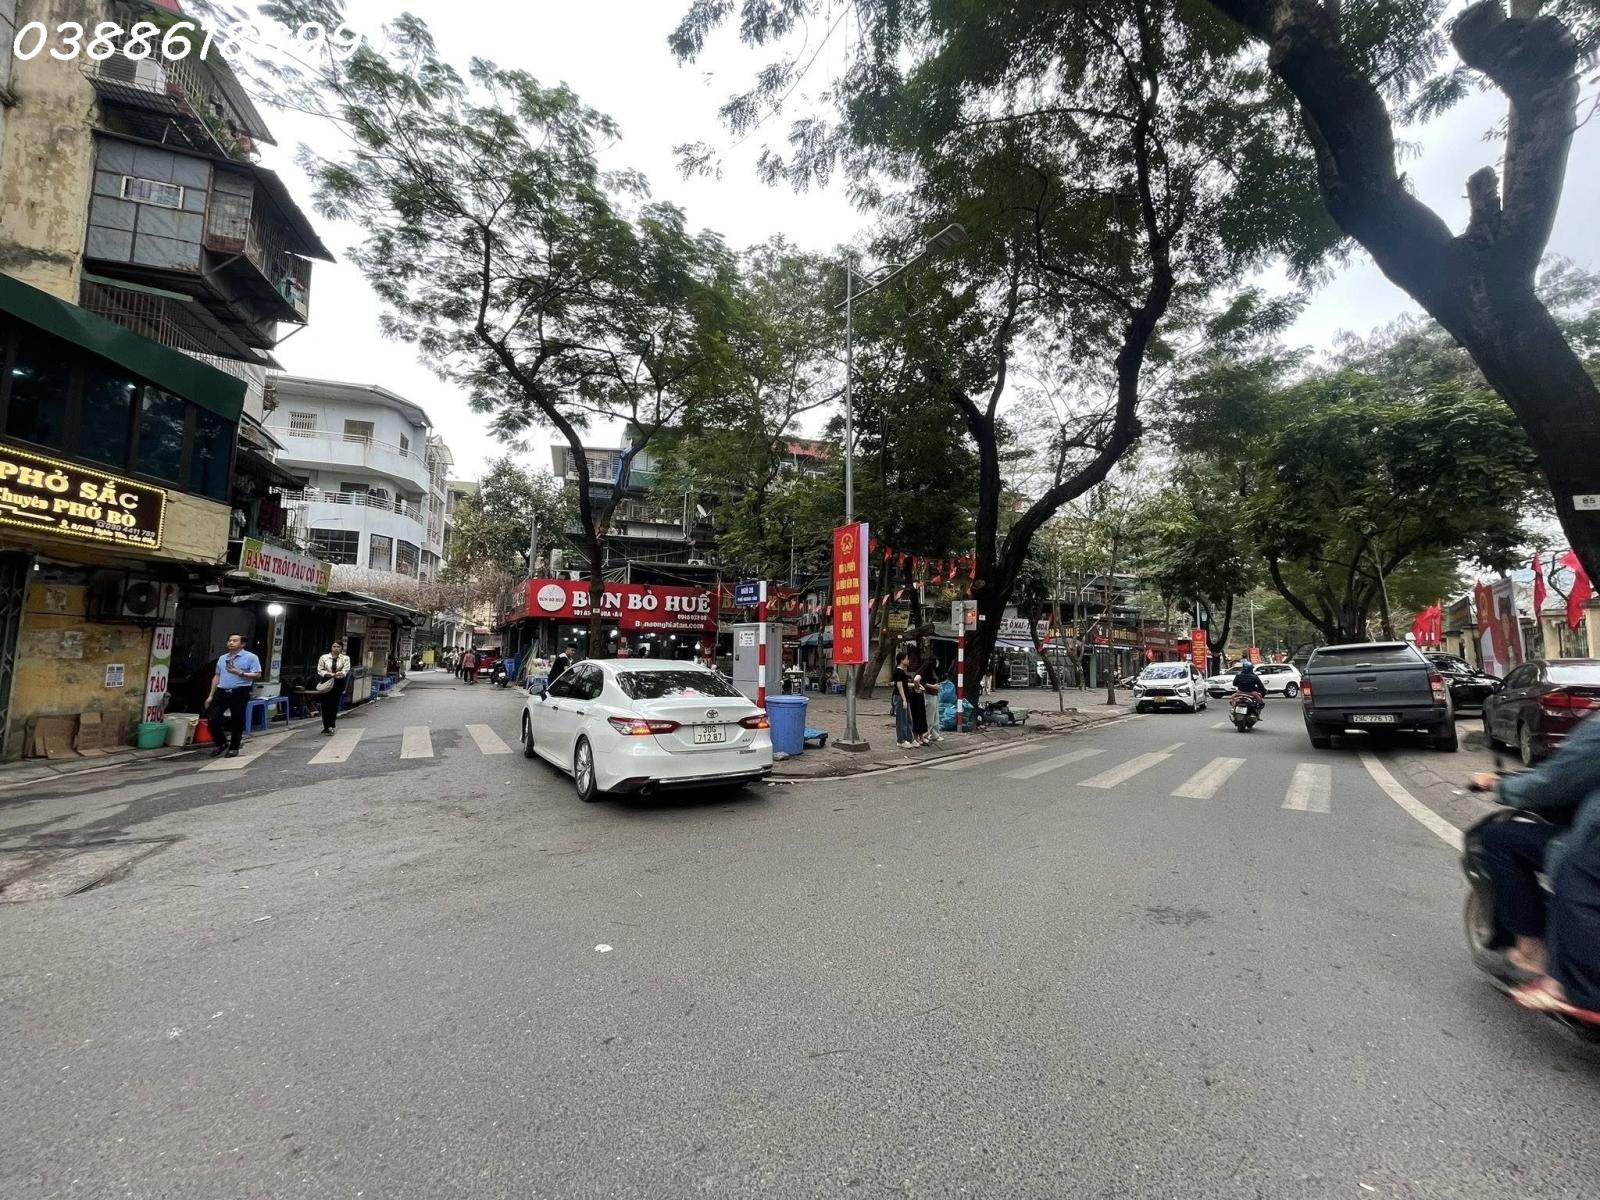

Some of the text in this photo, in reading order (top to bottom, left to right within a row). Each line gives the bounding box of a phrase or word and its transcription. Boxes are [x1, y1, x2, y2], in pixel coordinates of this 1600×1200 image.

[0, 461, 139, 509] PHỞ SẮC
[53, 498, 102, 520] PHỞ
[106, 510, 137, 528] BÒ
[245, 546, 271, 572] BÁNH
[290, 560, 306, 581] TÀU
[627, 589, 658, 611] BÒ
[664, 590, 711, 613] HUẾ
[156, 628, 171, 650] TÀU
[150, 671, 166, 693] TÀO
[703, 725, 716, 733] 30G
